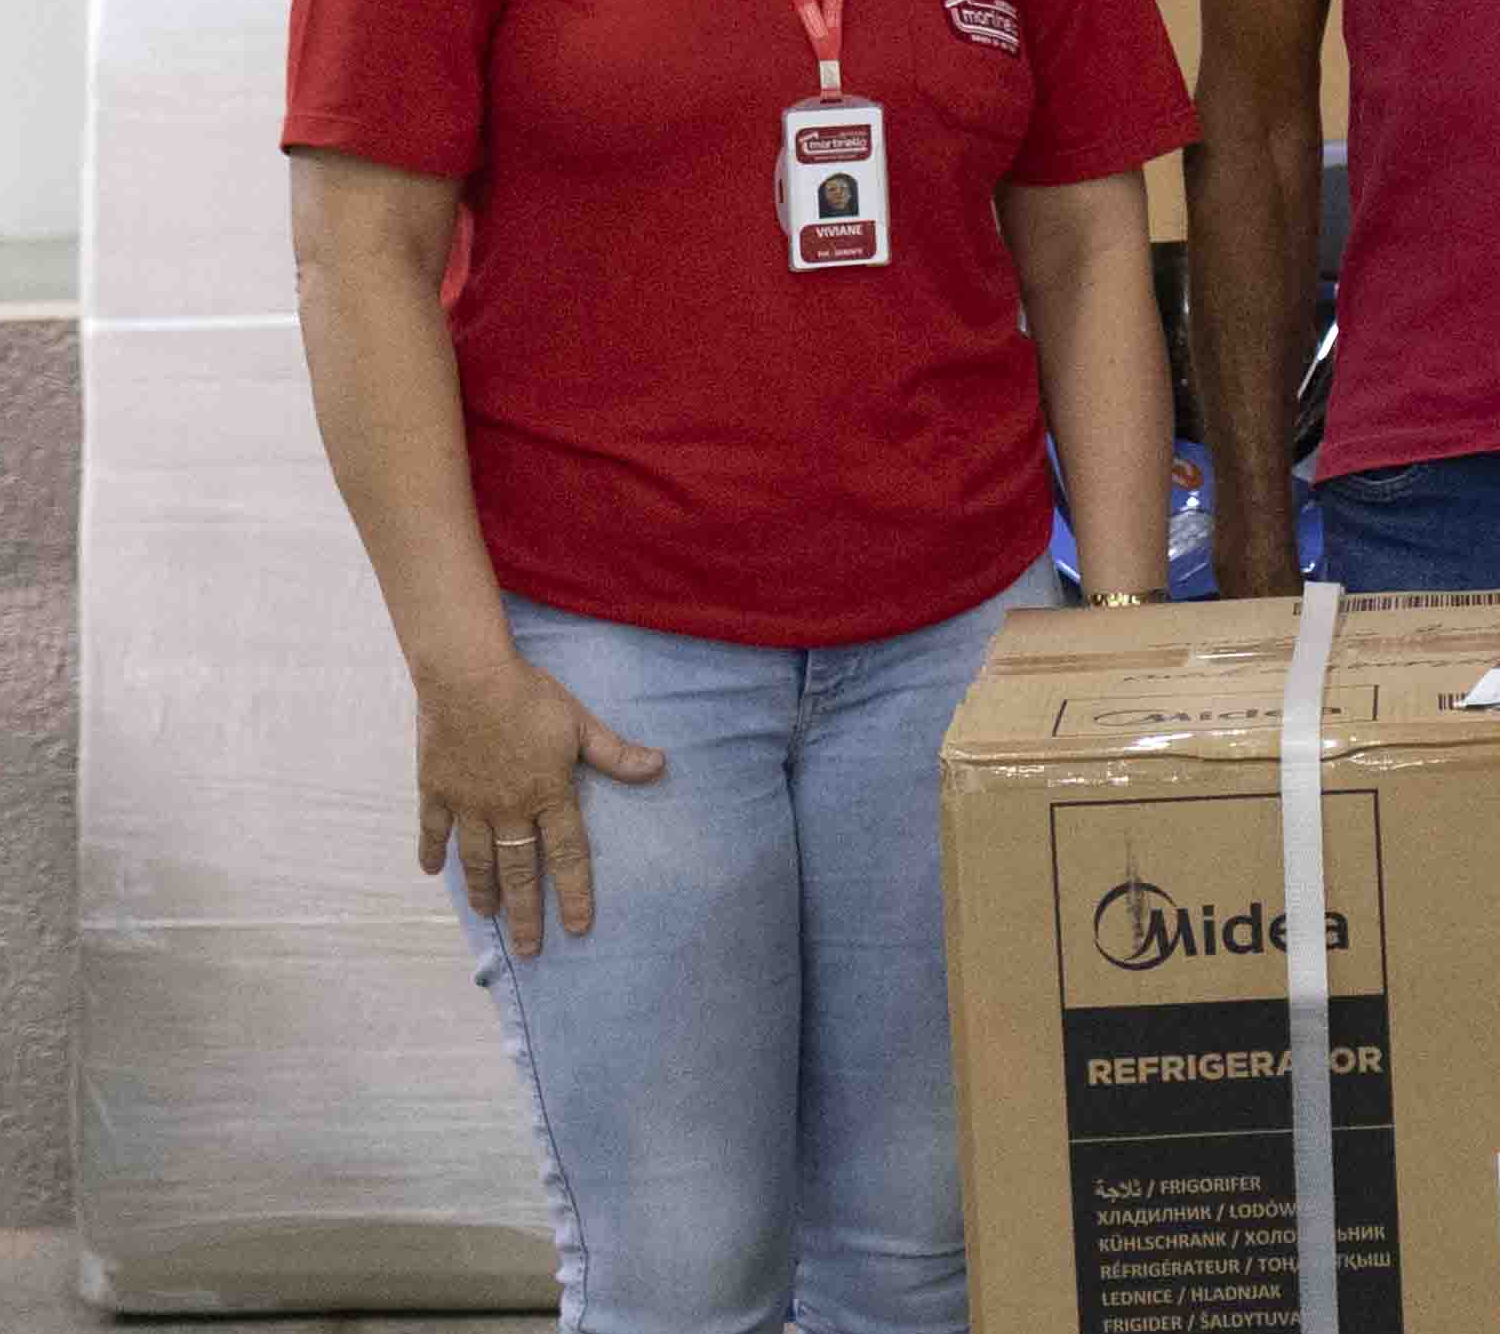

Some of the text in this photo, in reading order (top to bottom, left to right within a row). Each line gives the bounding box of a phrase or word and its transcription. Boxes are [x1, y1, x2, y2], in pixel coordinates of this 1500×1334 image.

[816, 224, 863, 237] VIVIANE
[1088, 1046, 1384, 1087] REFRIGERAOR
[1160, 1175, 1261, 1195] FRIGORIFER
[1099, 1230, 1227, 1252] KÜHLSCHRANK
[1244, 1226, 1386, 1245] ХОЛОЬНИК
[1101, 1287, 1173, 1307] LEDNICE
[1191, 1283, 1283, 1302] HLADNJAK
[1103, 1315, 1182, 1334] FRIGIDER
[1200, 1309, 1301, 1329] ŠALDYTUVA
